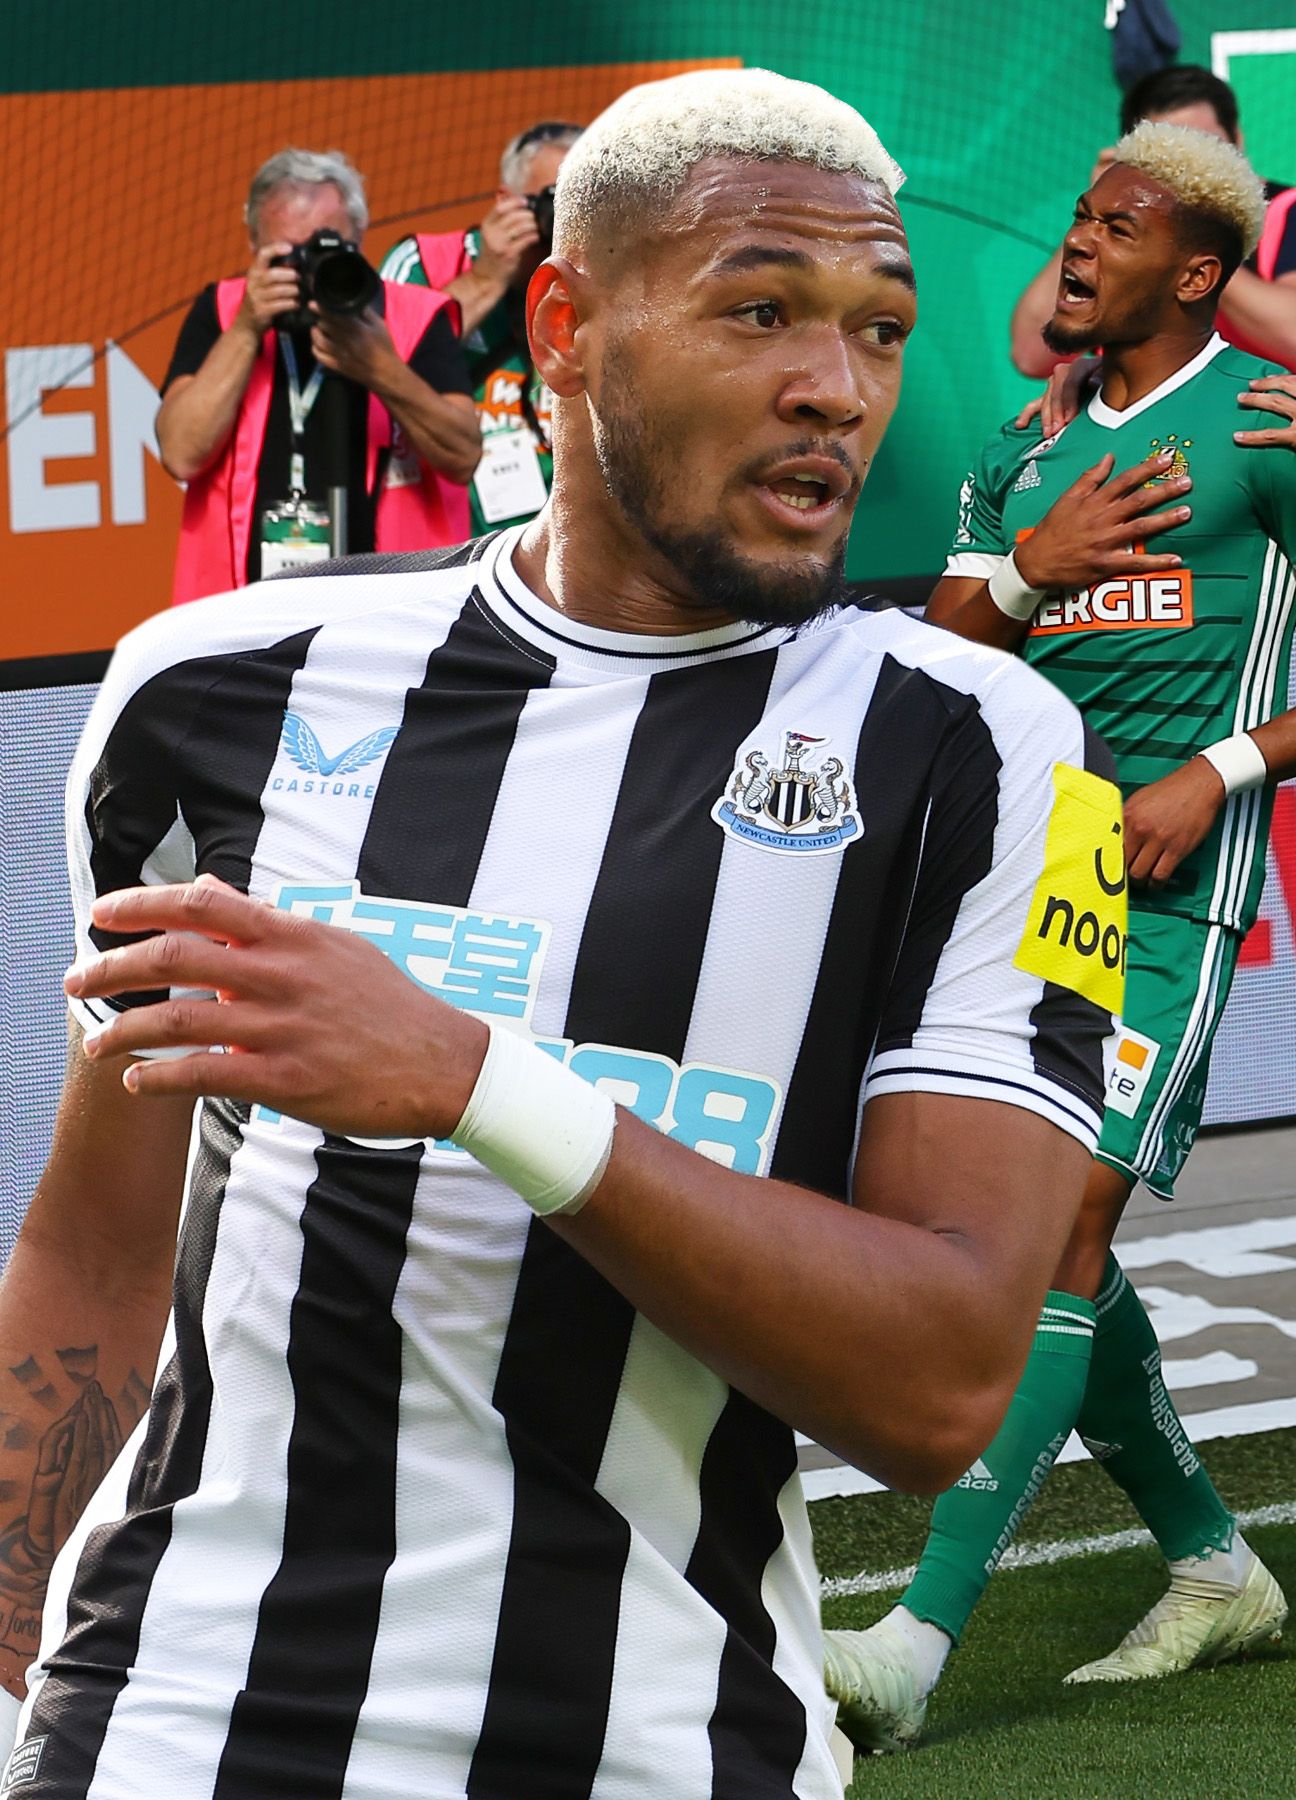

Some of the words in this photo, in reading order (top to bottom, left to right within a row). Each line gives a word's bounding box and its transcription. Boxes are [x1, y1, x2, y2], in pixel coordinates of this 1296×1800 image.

[1032, 578, 1182, 627] ERGIE
[272, 777, 375, 799] CASTORE
[736, 824, 797, 847] NEWCASTLE
[798, 835, 838, 847] UNITED
[1037, 895, 1128, 976] noo
[953, 1476, 1000, 1492] das
